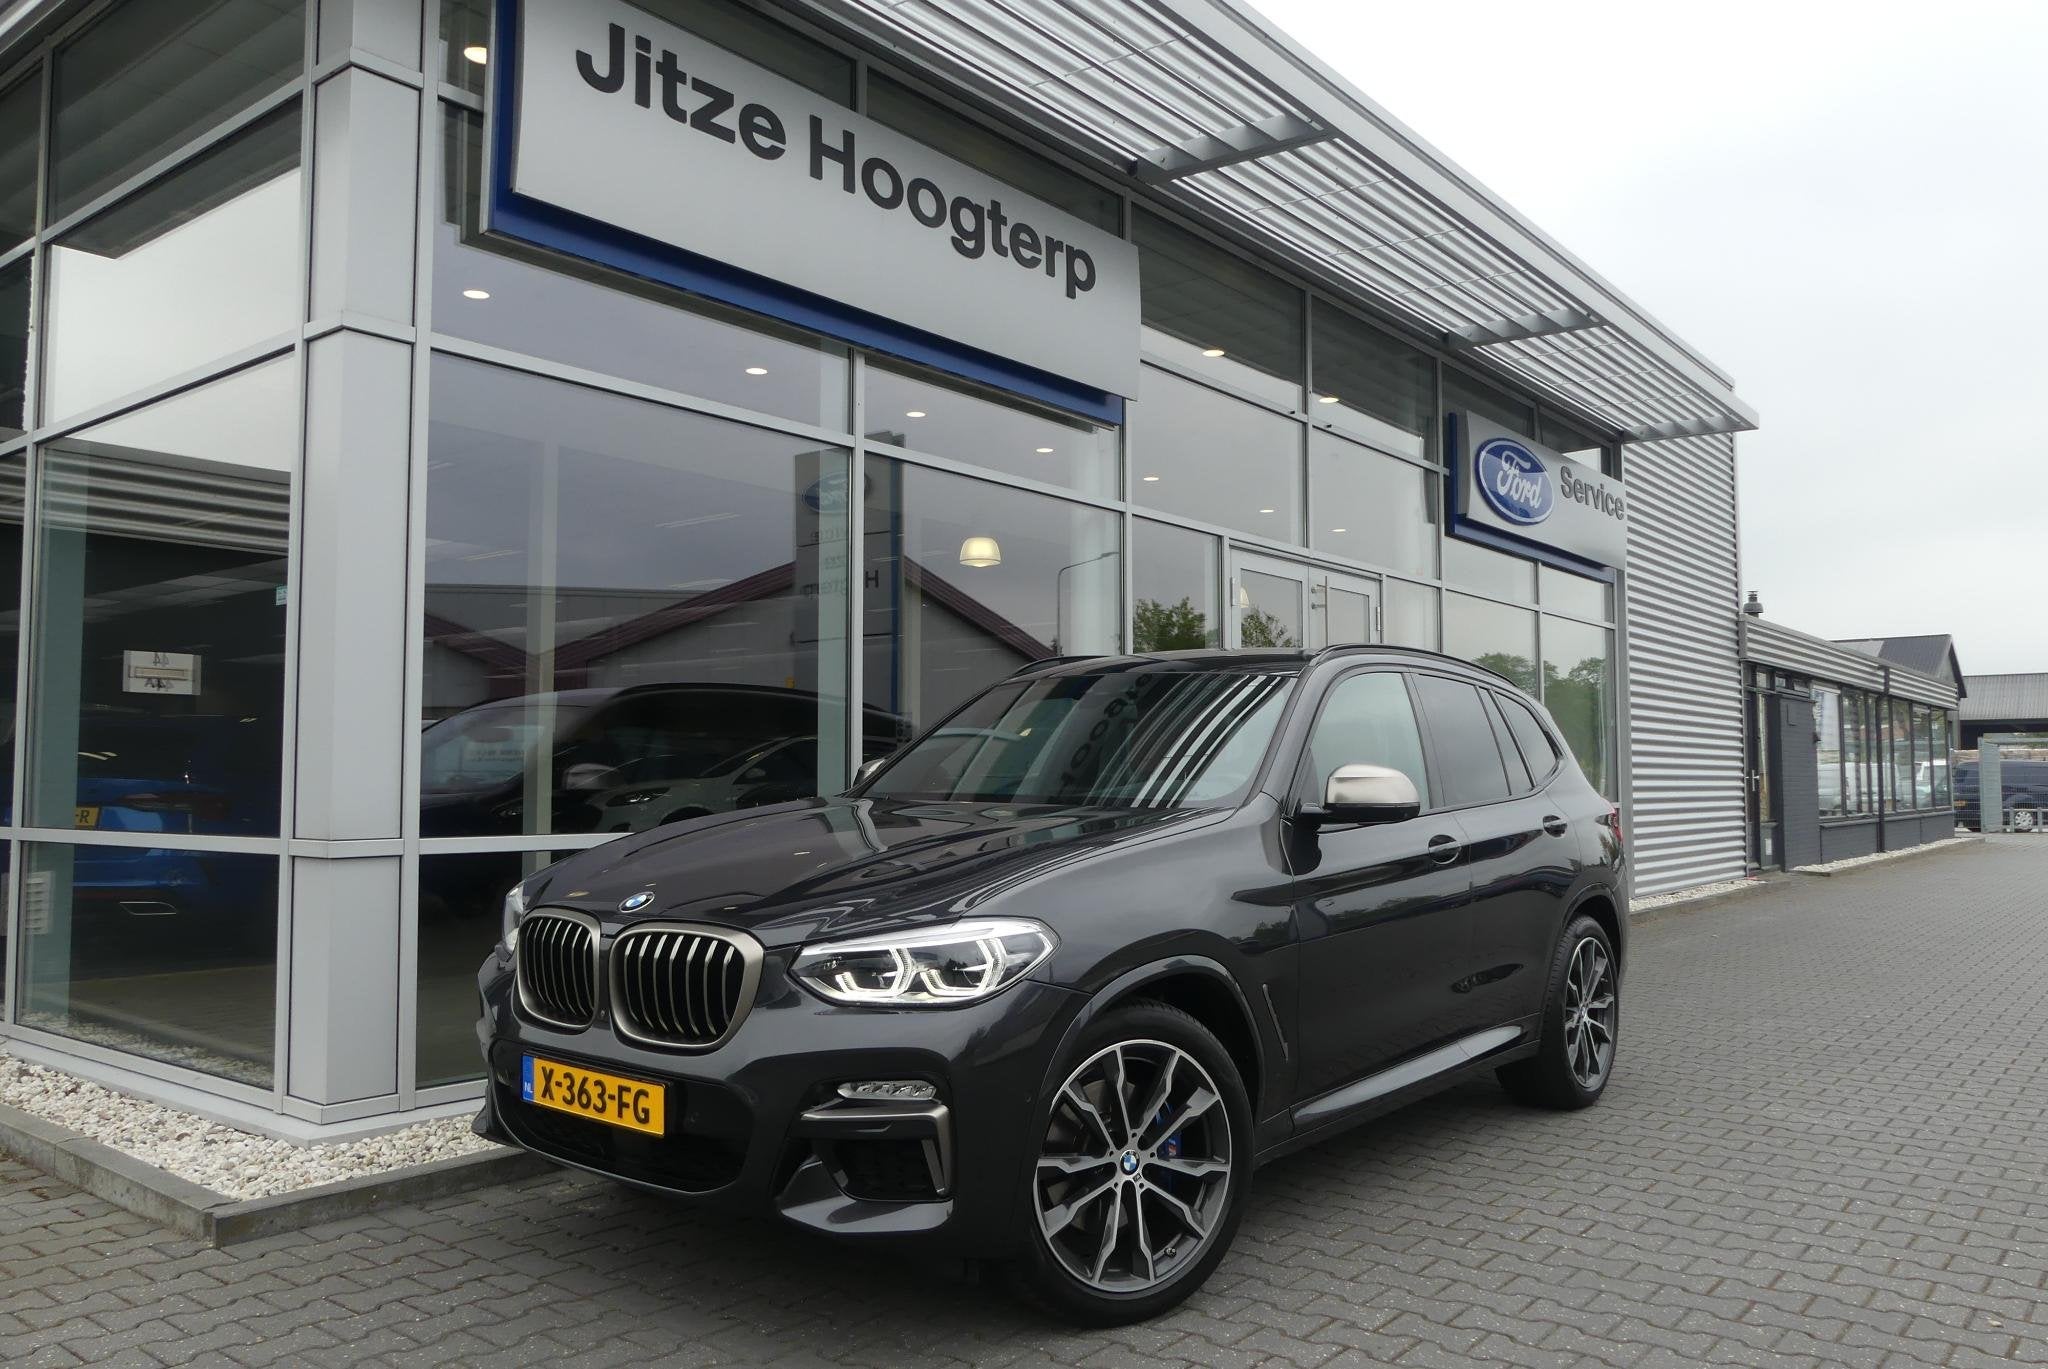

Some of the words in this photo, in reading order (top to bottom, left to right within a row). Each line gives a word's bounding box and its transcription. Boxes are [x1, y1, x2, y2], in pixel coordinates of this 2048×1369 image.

[576, 22, 787, 161] Jitze
[809, 114, 1097, 300] Hoogterp
[1496, 450, 1543, 510] Ford
[1560, 465, 1625, 521] Service
[524, 1081, 534, 1094] NL
[541, 1065, 650, 1125] X-363-FG
